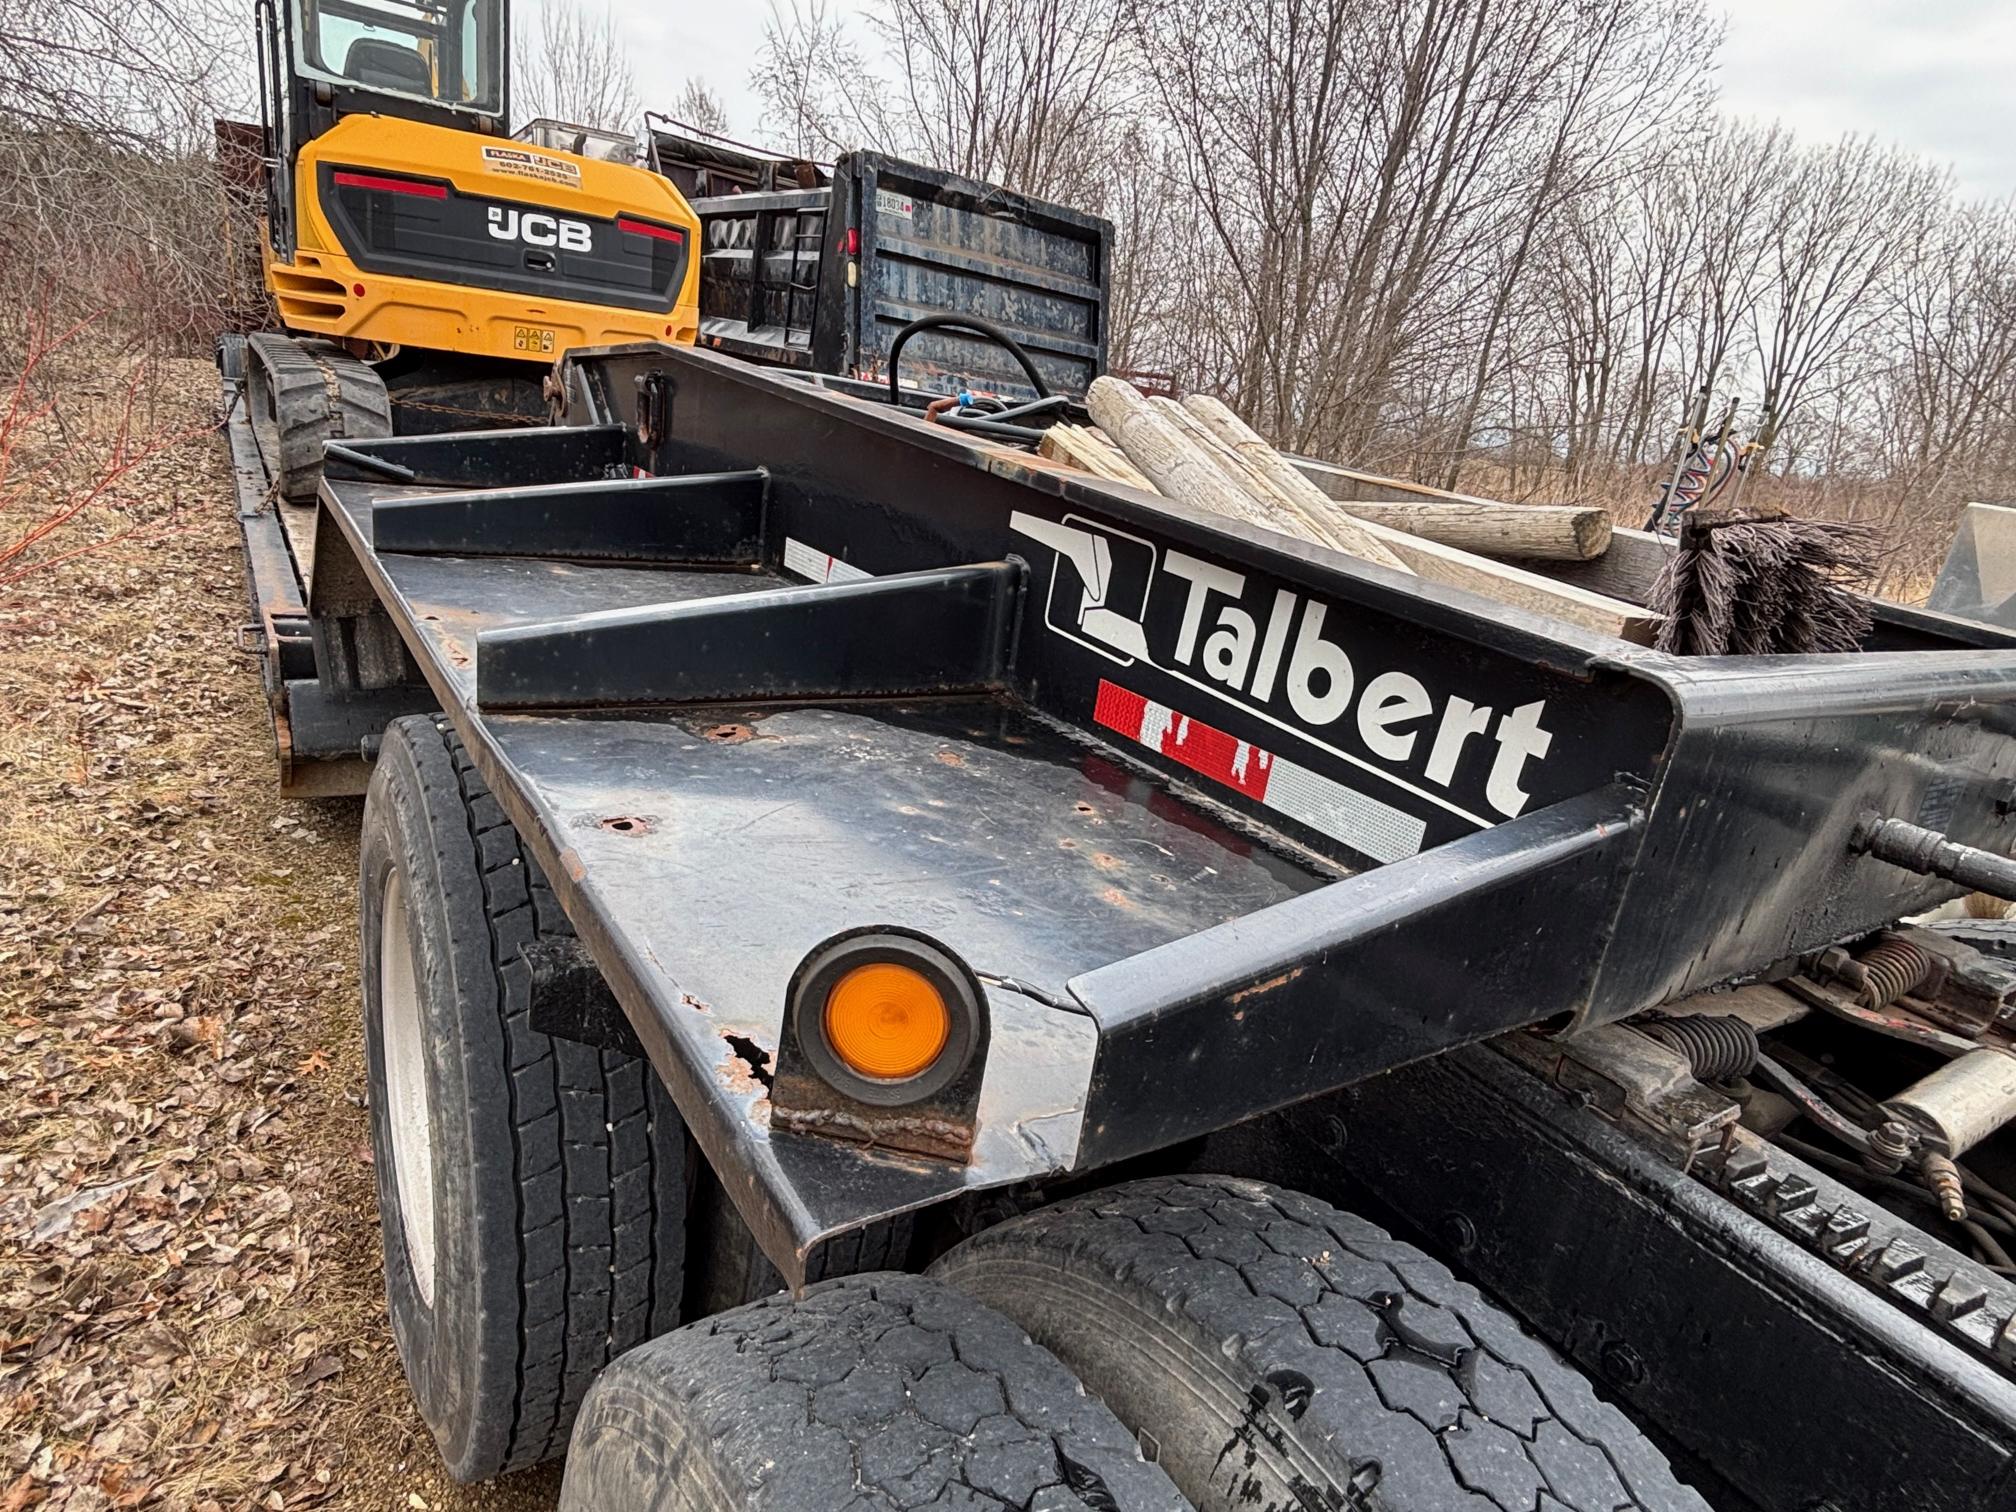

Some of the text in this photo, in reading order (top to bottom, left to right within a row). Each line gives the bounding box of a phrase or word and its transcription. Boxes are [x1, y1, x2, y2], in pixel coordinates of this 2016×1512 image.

[489, 150, 578, 175] FLASKA JCB
[488, 206, 592, 252] JCB
[1162, 548, 1553, 819] Talbert
